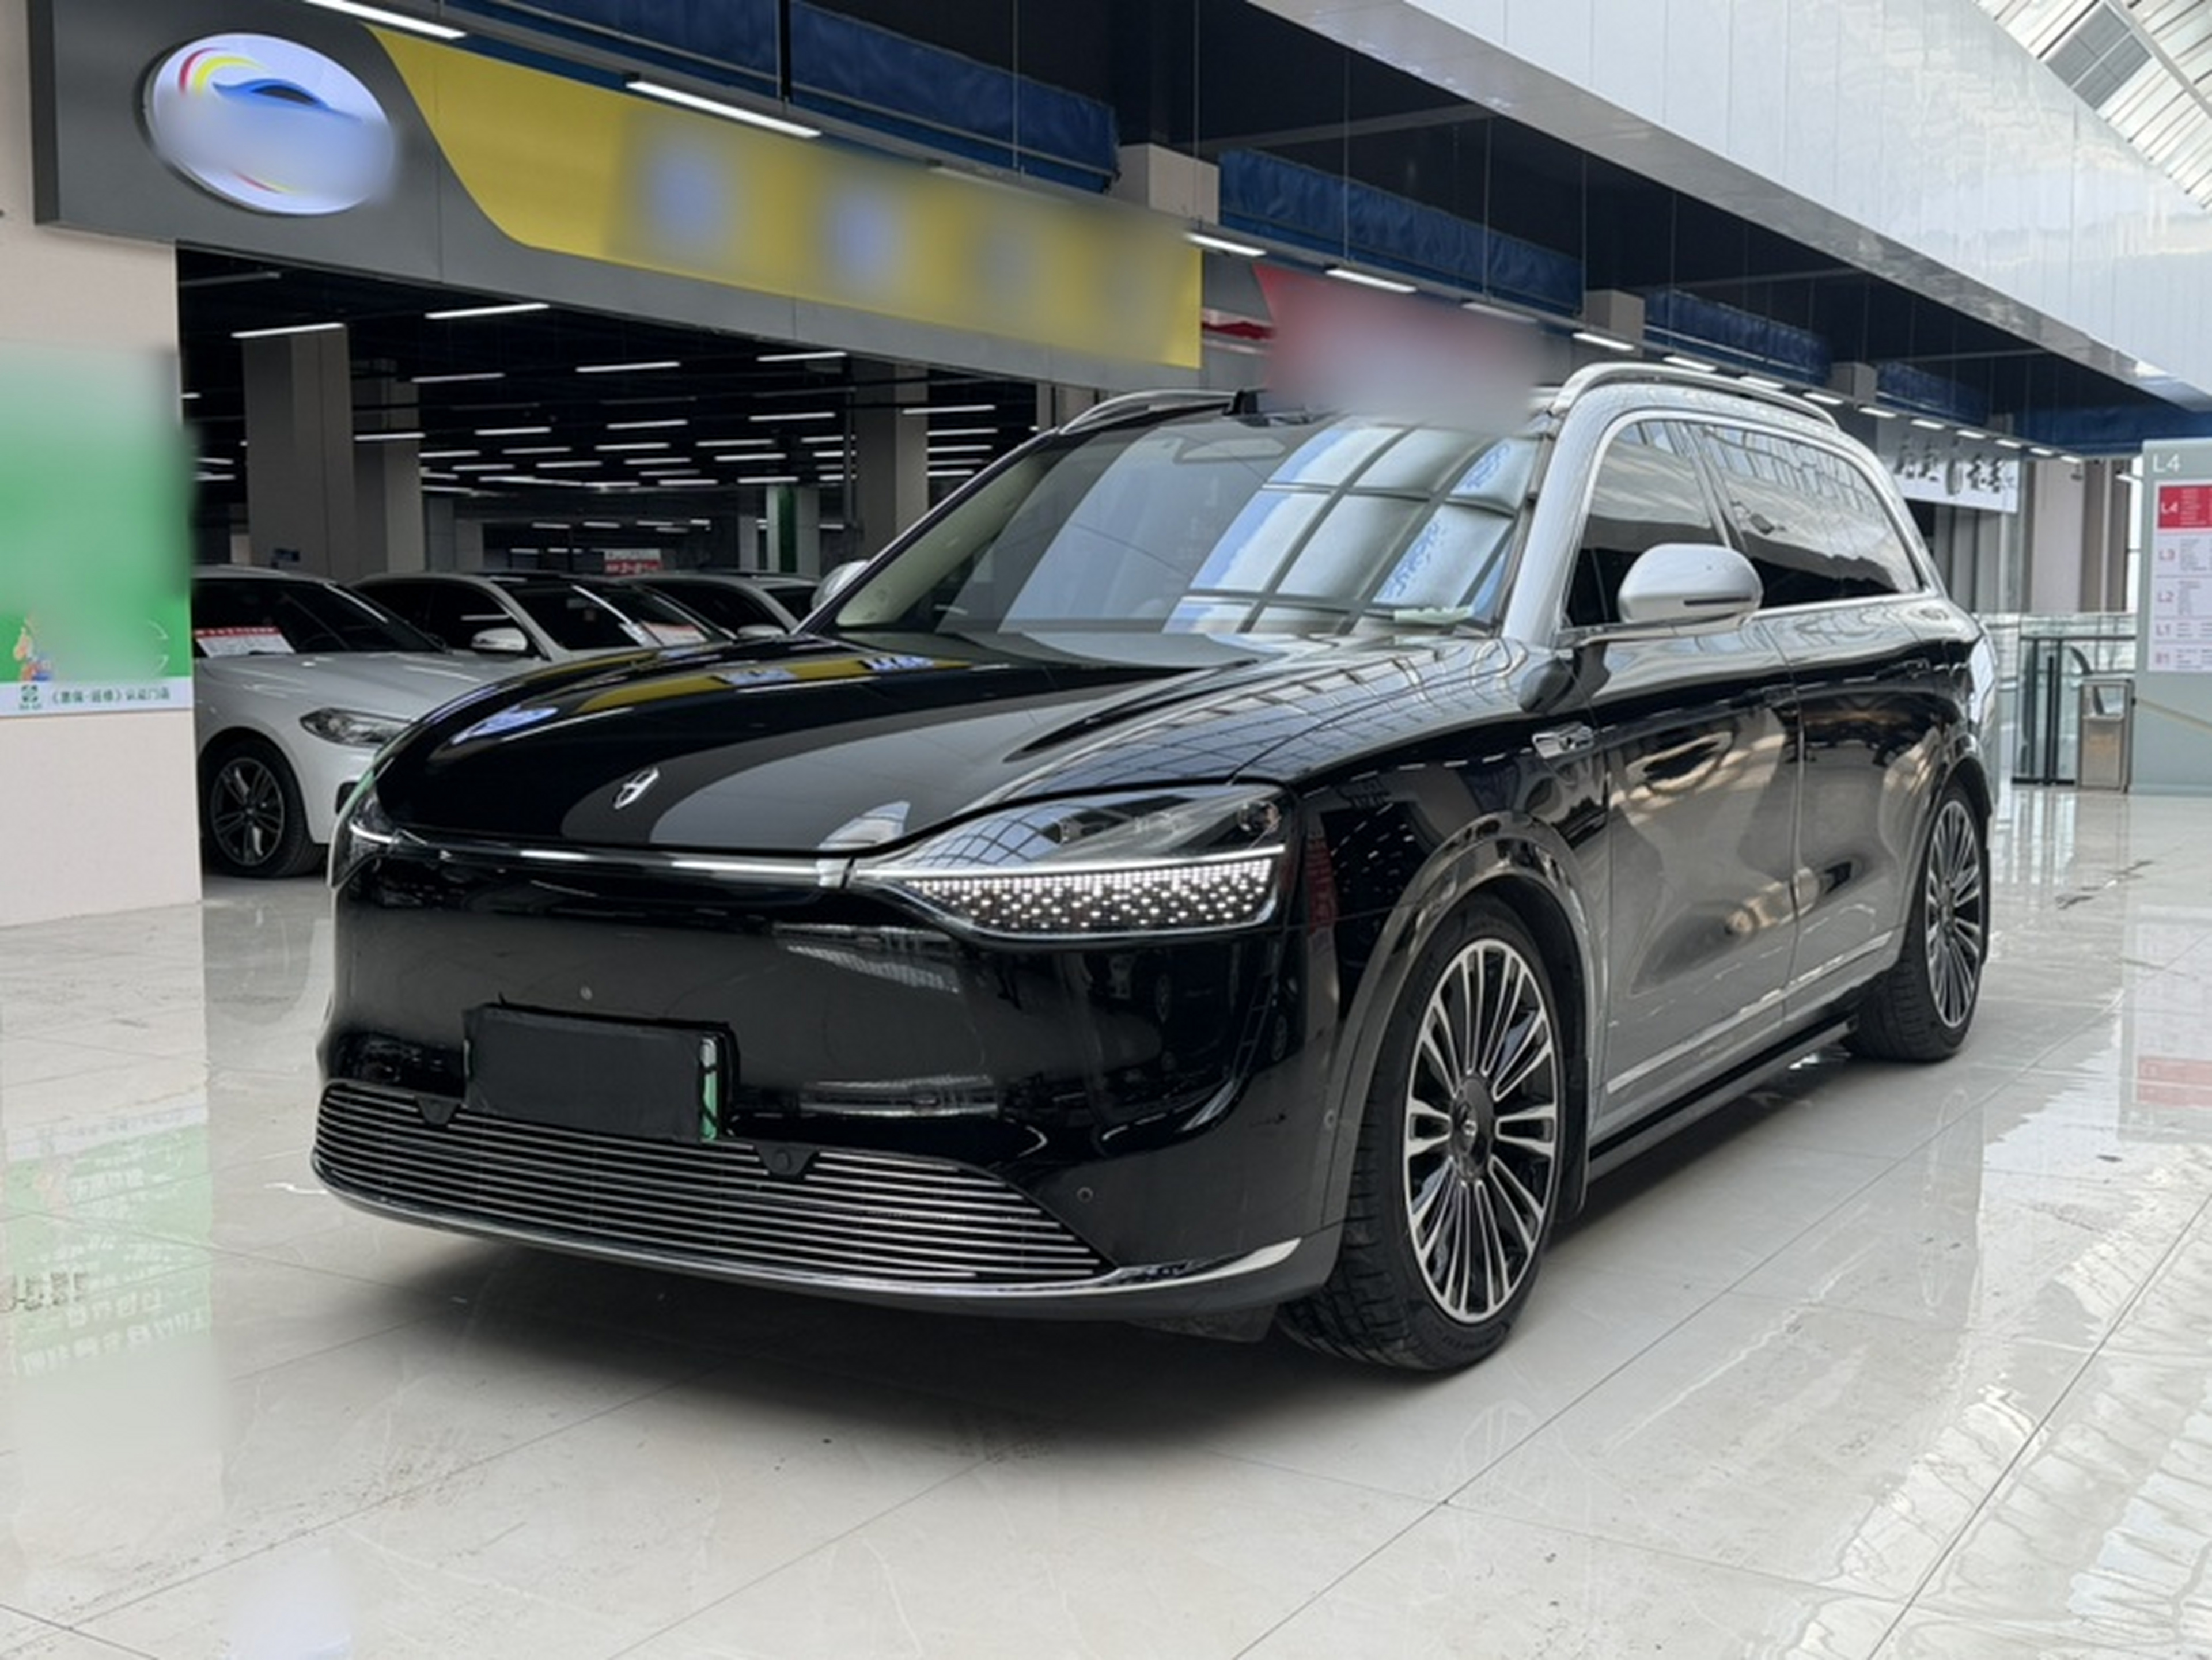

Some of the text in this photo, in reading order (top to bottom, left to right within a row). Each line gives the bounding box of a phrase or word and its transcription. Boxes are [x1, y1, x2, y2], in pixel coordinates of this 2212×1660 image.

[2153, 454, 2181, 473] L4
[2161, 501, 2179, 514] L4
[2157, 590, 2175, 602] L2
[2156, 624, 2171, 636] L1
